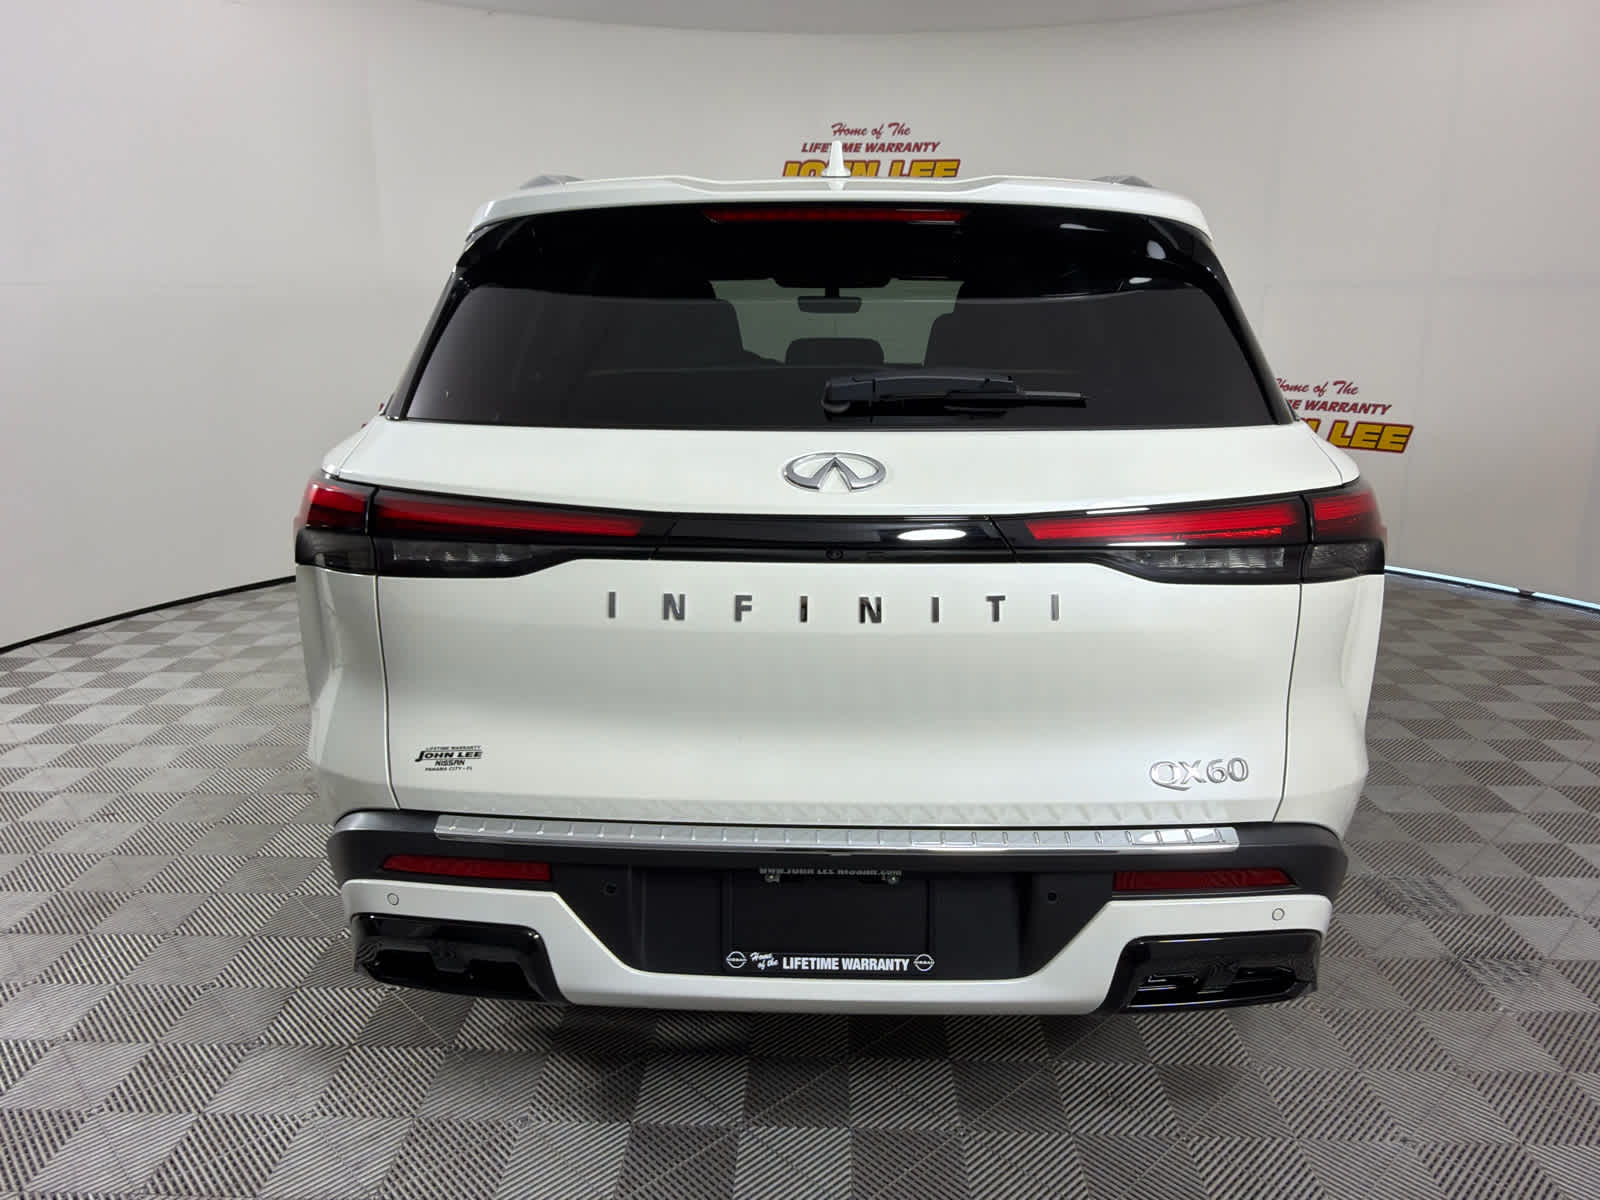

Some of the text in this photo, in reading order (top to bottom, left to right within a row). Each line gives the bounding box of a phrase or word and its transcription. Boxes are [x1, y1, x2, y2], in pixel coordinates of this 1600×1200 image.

[831, 122, 911, 139] Home of The
[801, 141, 941, 153] LIFEME WARRANTY
[782, 159, 961, 177] JON LEE
[1313, 381, 1328, 397] of
[1332, 380, 1359, 395] The
[1304, 399, 1392, 415] WARRANTY
[1326, 419, 1414, 454] LEE
[607, 591, 1061, 624] INFINITI
[1149, 757, 1249, 791] QX60
[750, 951, 773, 962] Home
[766, 958, 779, 967] the
[782, 957, 910, 971] LIFETIME WARRANTY
